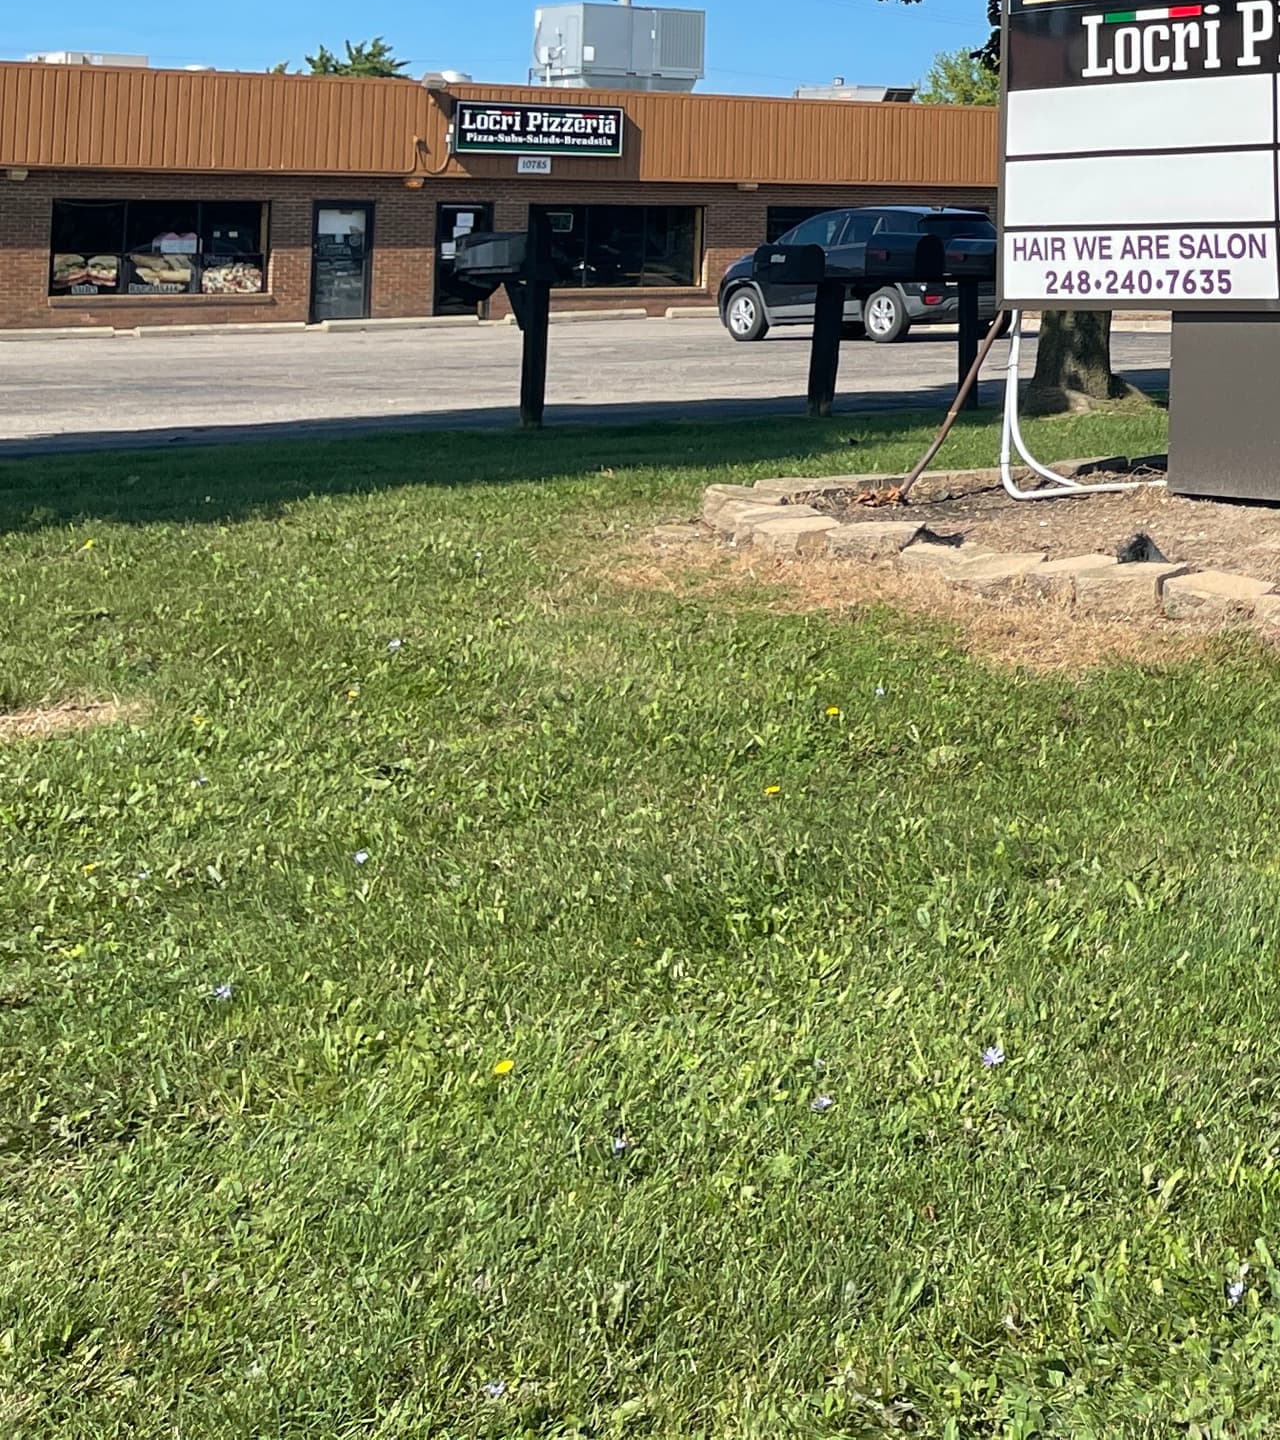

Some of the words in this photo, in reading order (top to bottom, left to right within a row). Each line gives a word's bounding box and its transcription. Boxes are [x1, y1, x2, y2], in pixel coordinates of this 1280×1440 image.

[1081, 4, 1221, 78] Locri
[461, 109, 521, 131] Locri
[526, 111, 617, 134] Pizzeria
[522, 161, 547, 170] 10785
[1013, 237, 1066, 261] HAIR
[1073, 235, 1112, 260] WE
[1120, 234, 1170, 260] ARE
[1179, 233, 1266, 259] SALON
